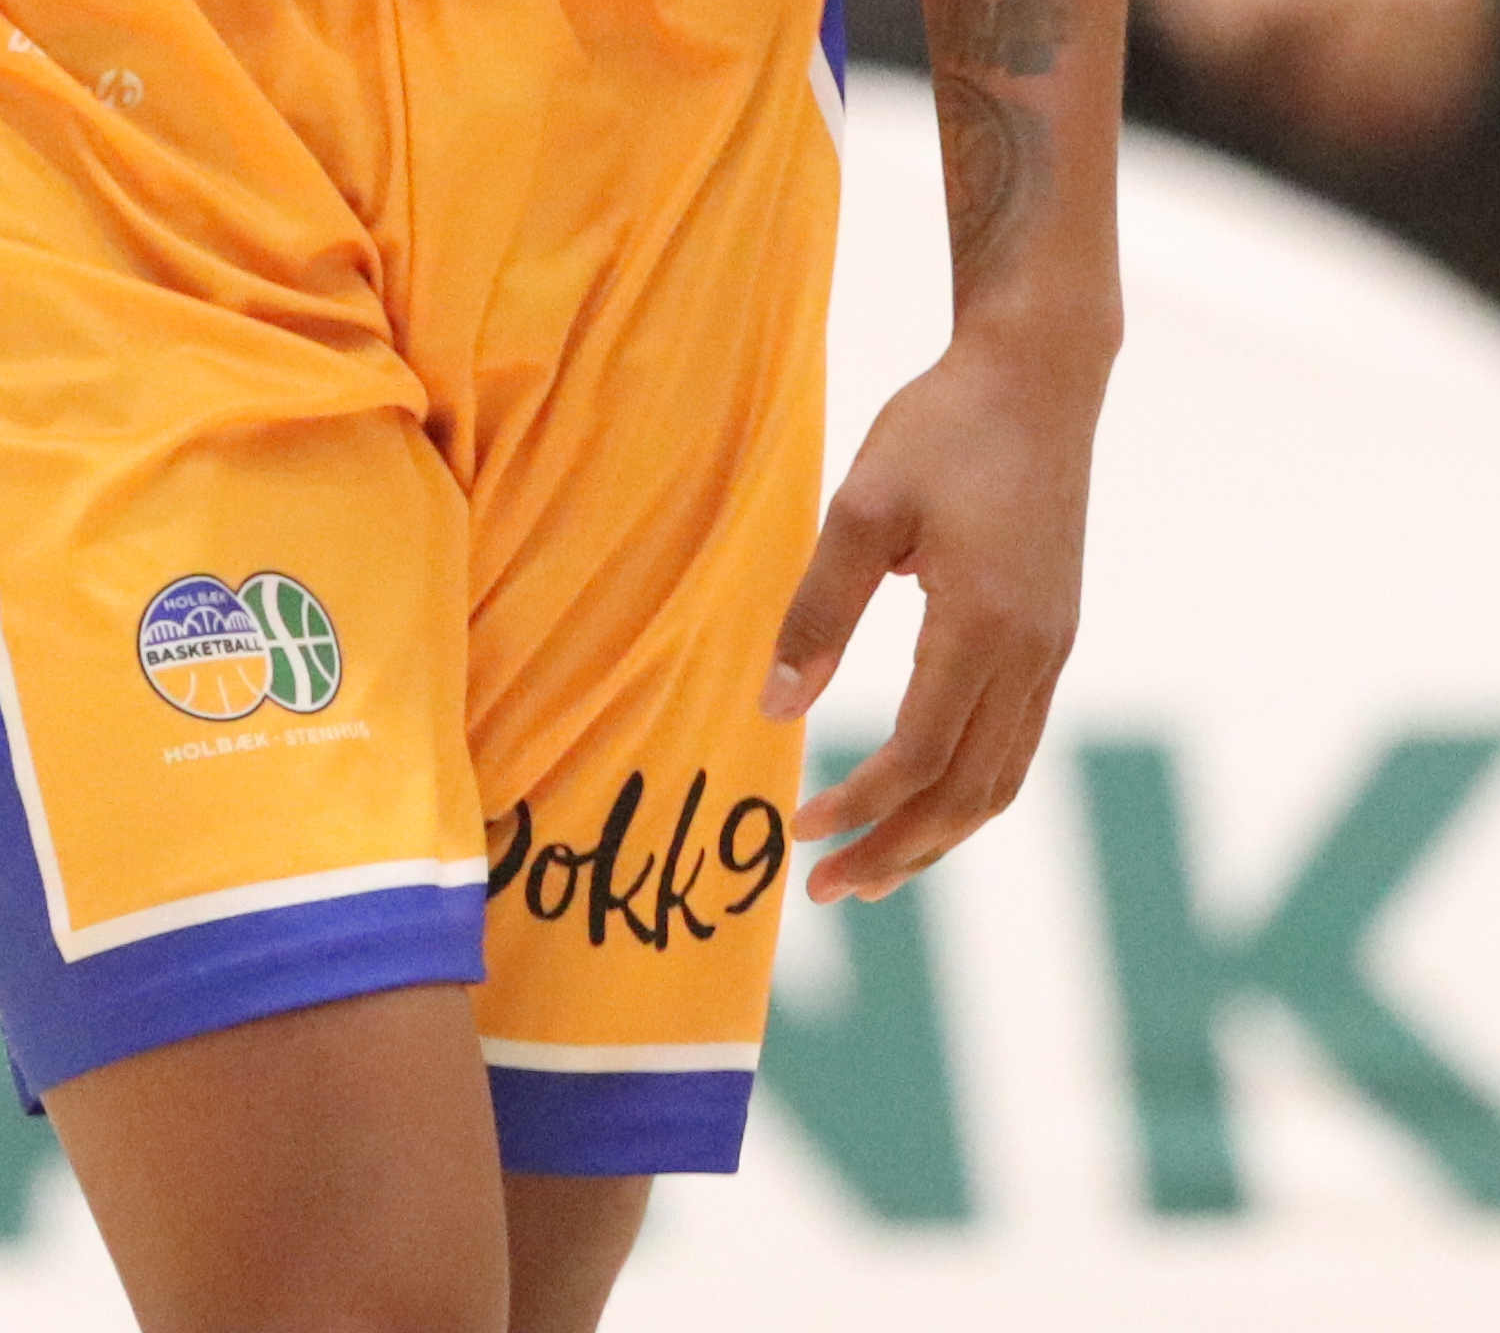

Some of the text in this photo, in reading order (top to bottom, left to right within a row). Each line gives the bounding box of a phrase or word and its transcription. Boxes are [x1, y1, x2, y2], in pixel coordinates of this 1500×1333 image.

[146, 637, 263, 666] BASKETBALL
[162, 719, 372, 765] HOLBÆK STENHUS
